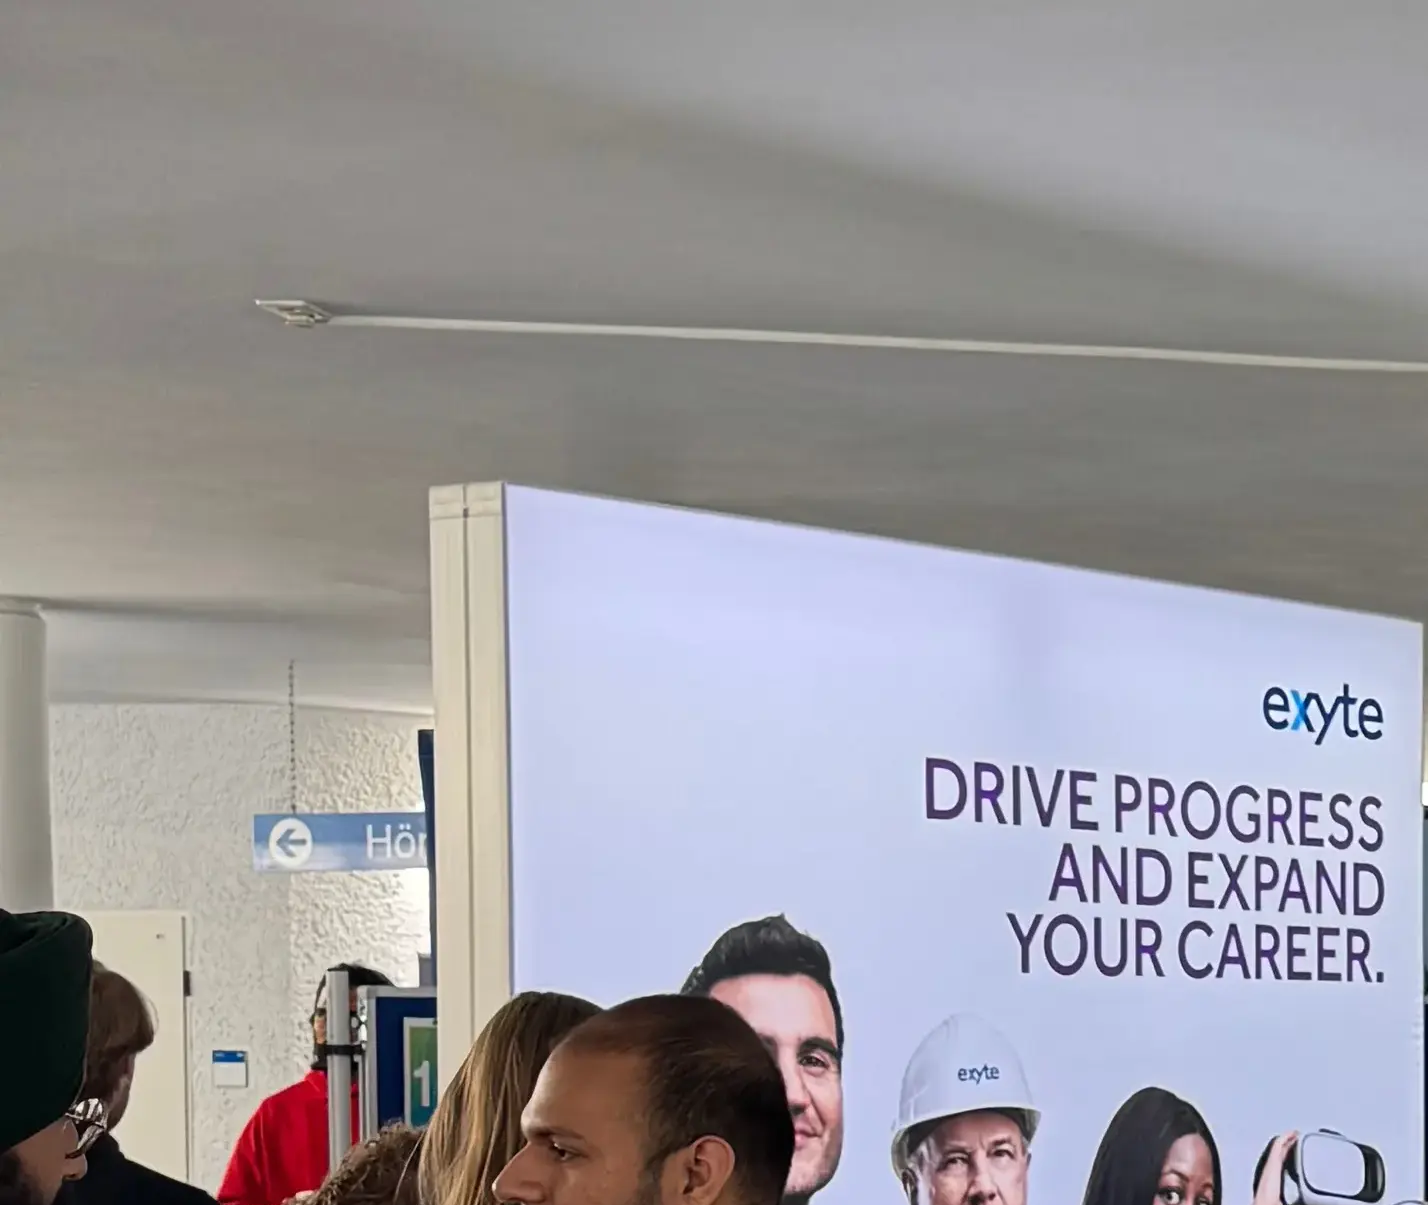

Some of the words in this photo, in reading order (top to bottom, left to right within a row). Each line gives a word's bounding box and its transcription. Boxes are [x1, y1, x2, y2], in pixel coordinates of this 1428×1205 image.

[1263, 683, 1384, 745] exyte
[924, 757, 1099, 831] DRIVE
[1115, 774, 1385, 852] PROGRESS
[1048, 842, 1173, 906] AND
[1187, 851, 1386, 917] EXPAND
[1006, 912, 1167, 978] YOUR
[1178, 920, 1386, 983] CAREER.
[957, 1061, 1001, 1084] exyte
